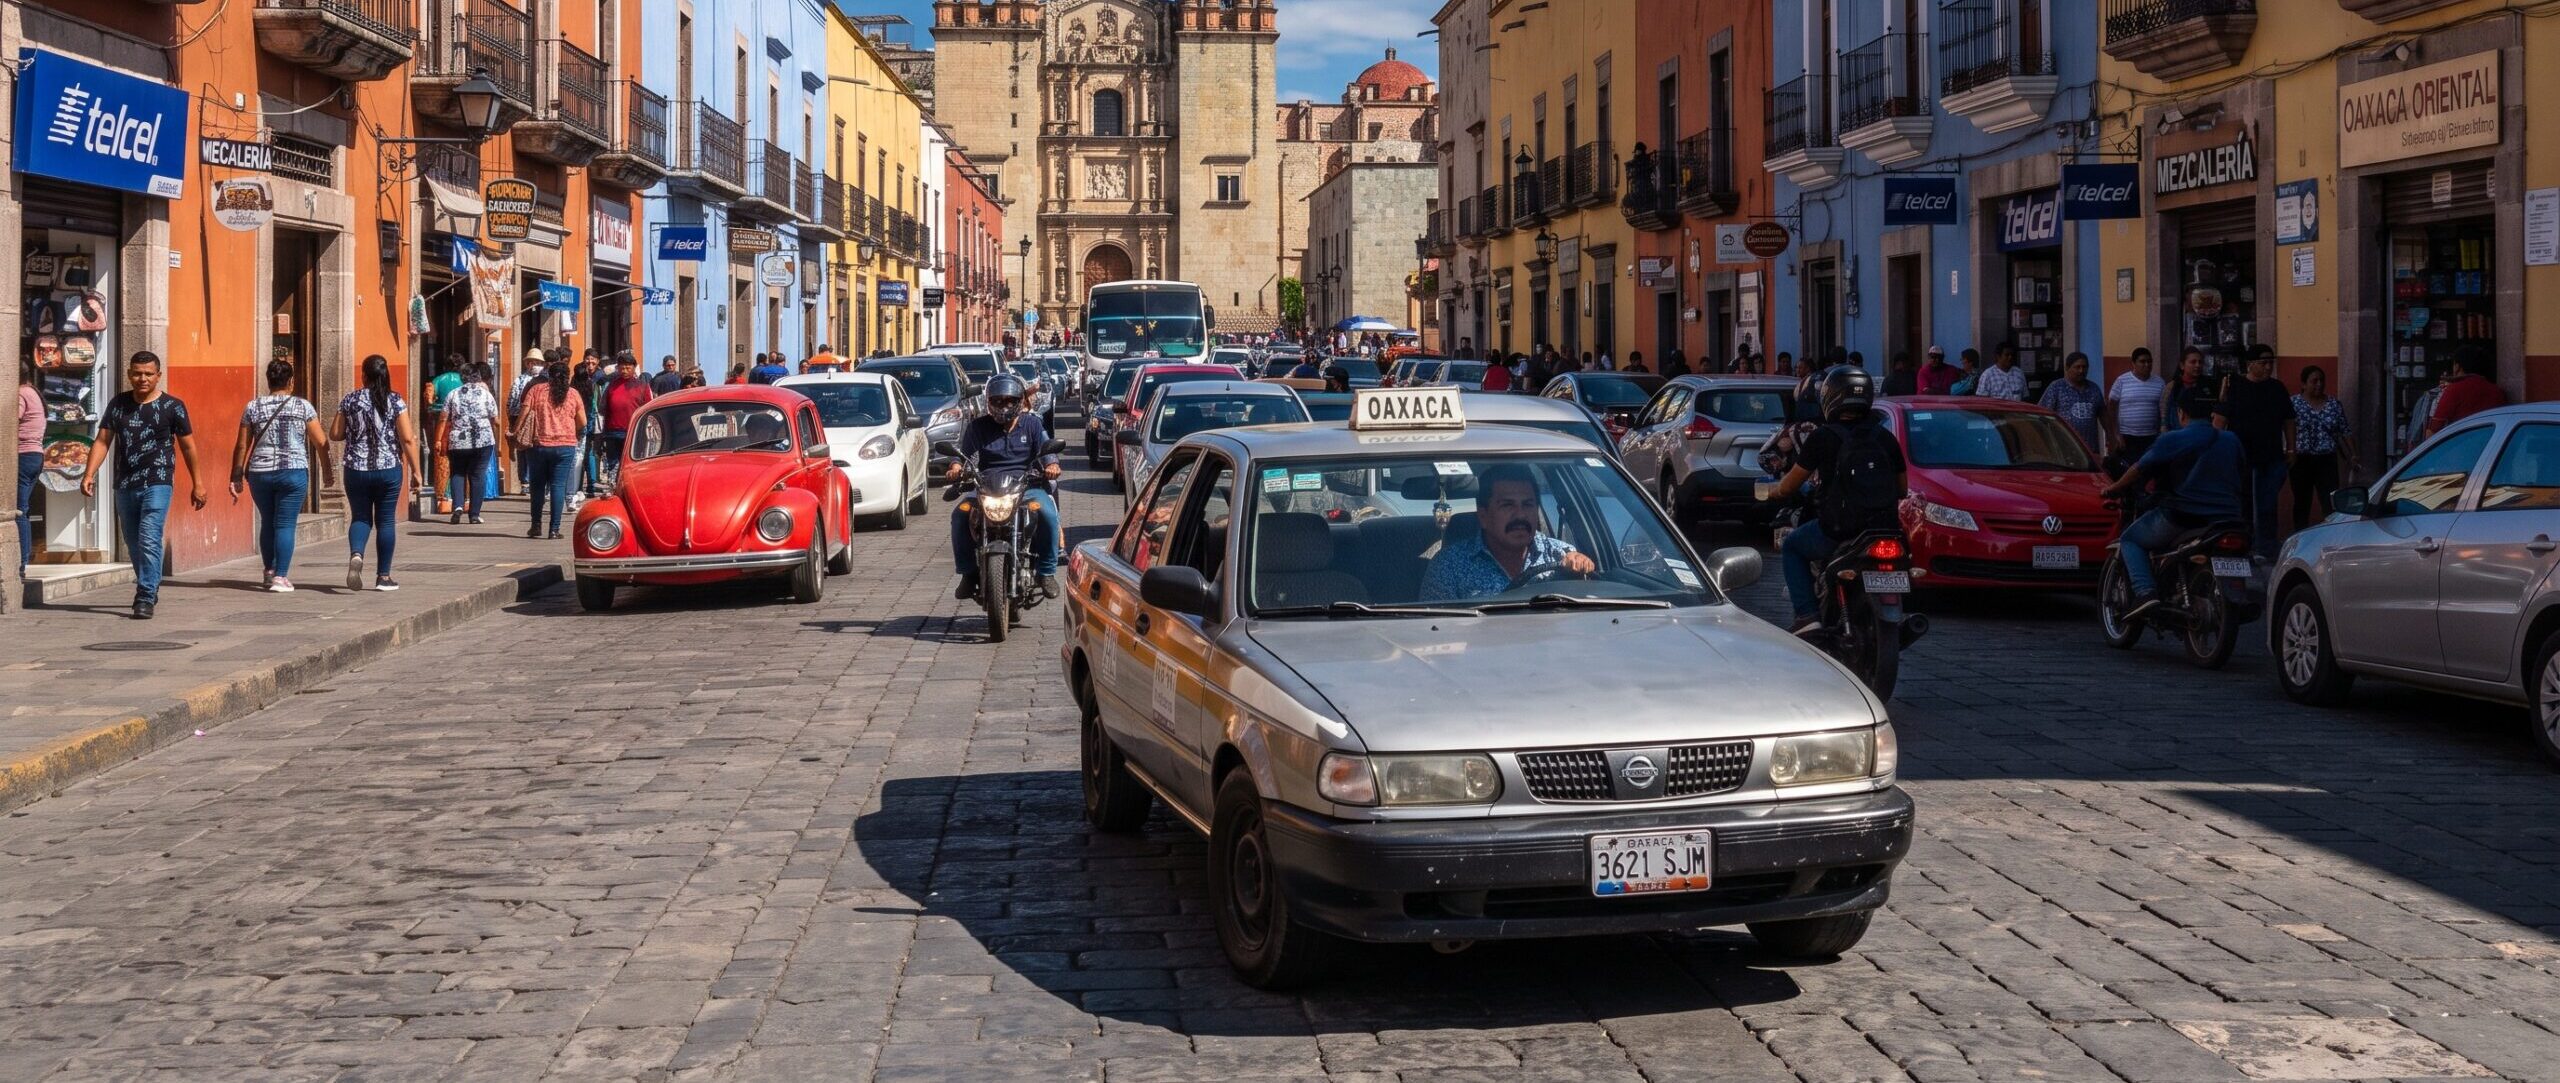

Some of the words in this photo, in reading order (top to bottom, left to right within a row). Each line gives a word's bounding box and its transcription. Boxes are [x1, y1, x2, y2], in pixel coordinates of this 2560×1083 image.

[2343, 86, 2408, 133] OAXACA
[2412, 66, 2496, 120] ORIENTAL
[84, 97, 162, 164] telcel
[2157, 130, 2254, 193] MEZCALERÍA
[1904, 192, 1952, 210] telcel
[2077, 181, 2133, 202] telcel
[2004, 189, 2062, 244] telcel
[674, 239, 705, 250] telcel
[1368, 396, 1453, 420] OAXACA
[1598, 850, 1650, 880] 3621
[1663, 846, 1706, 876] SJM
